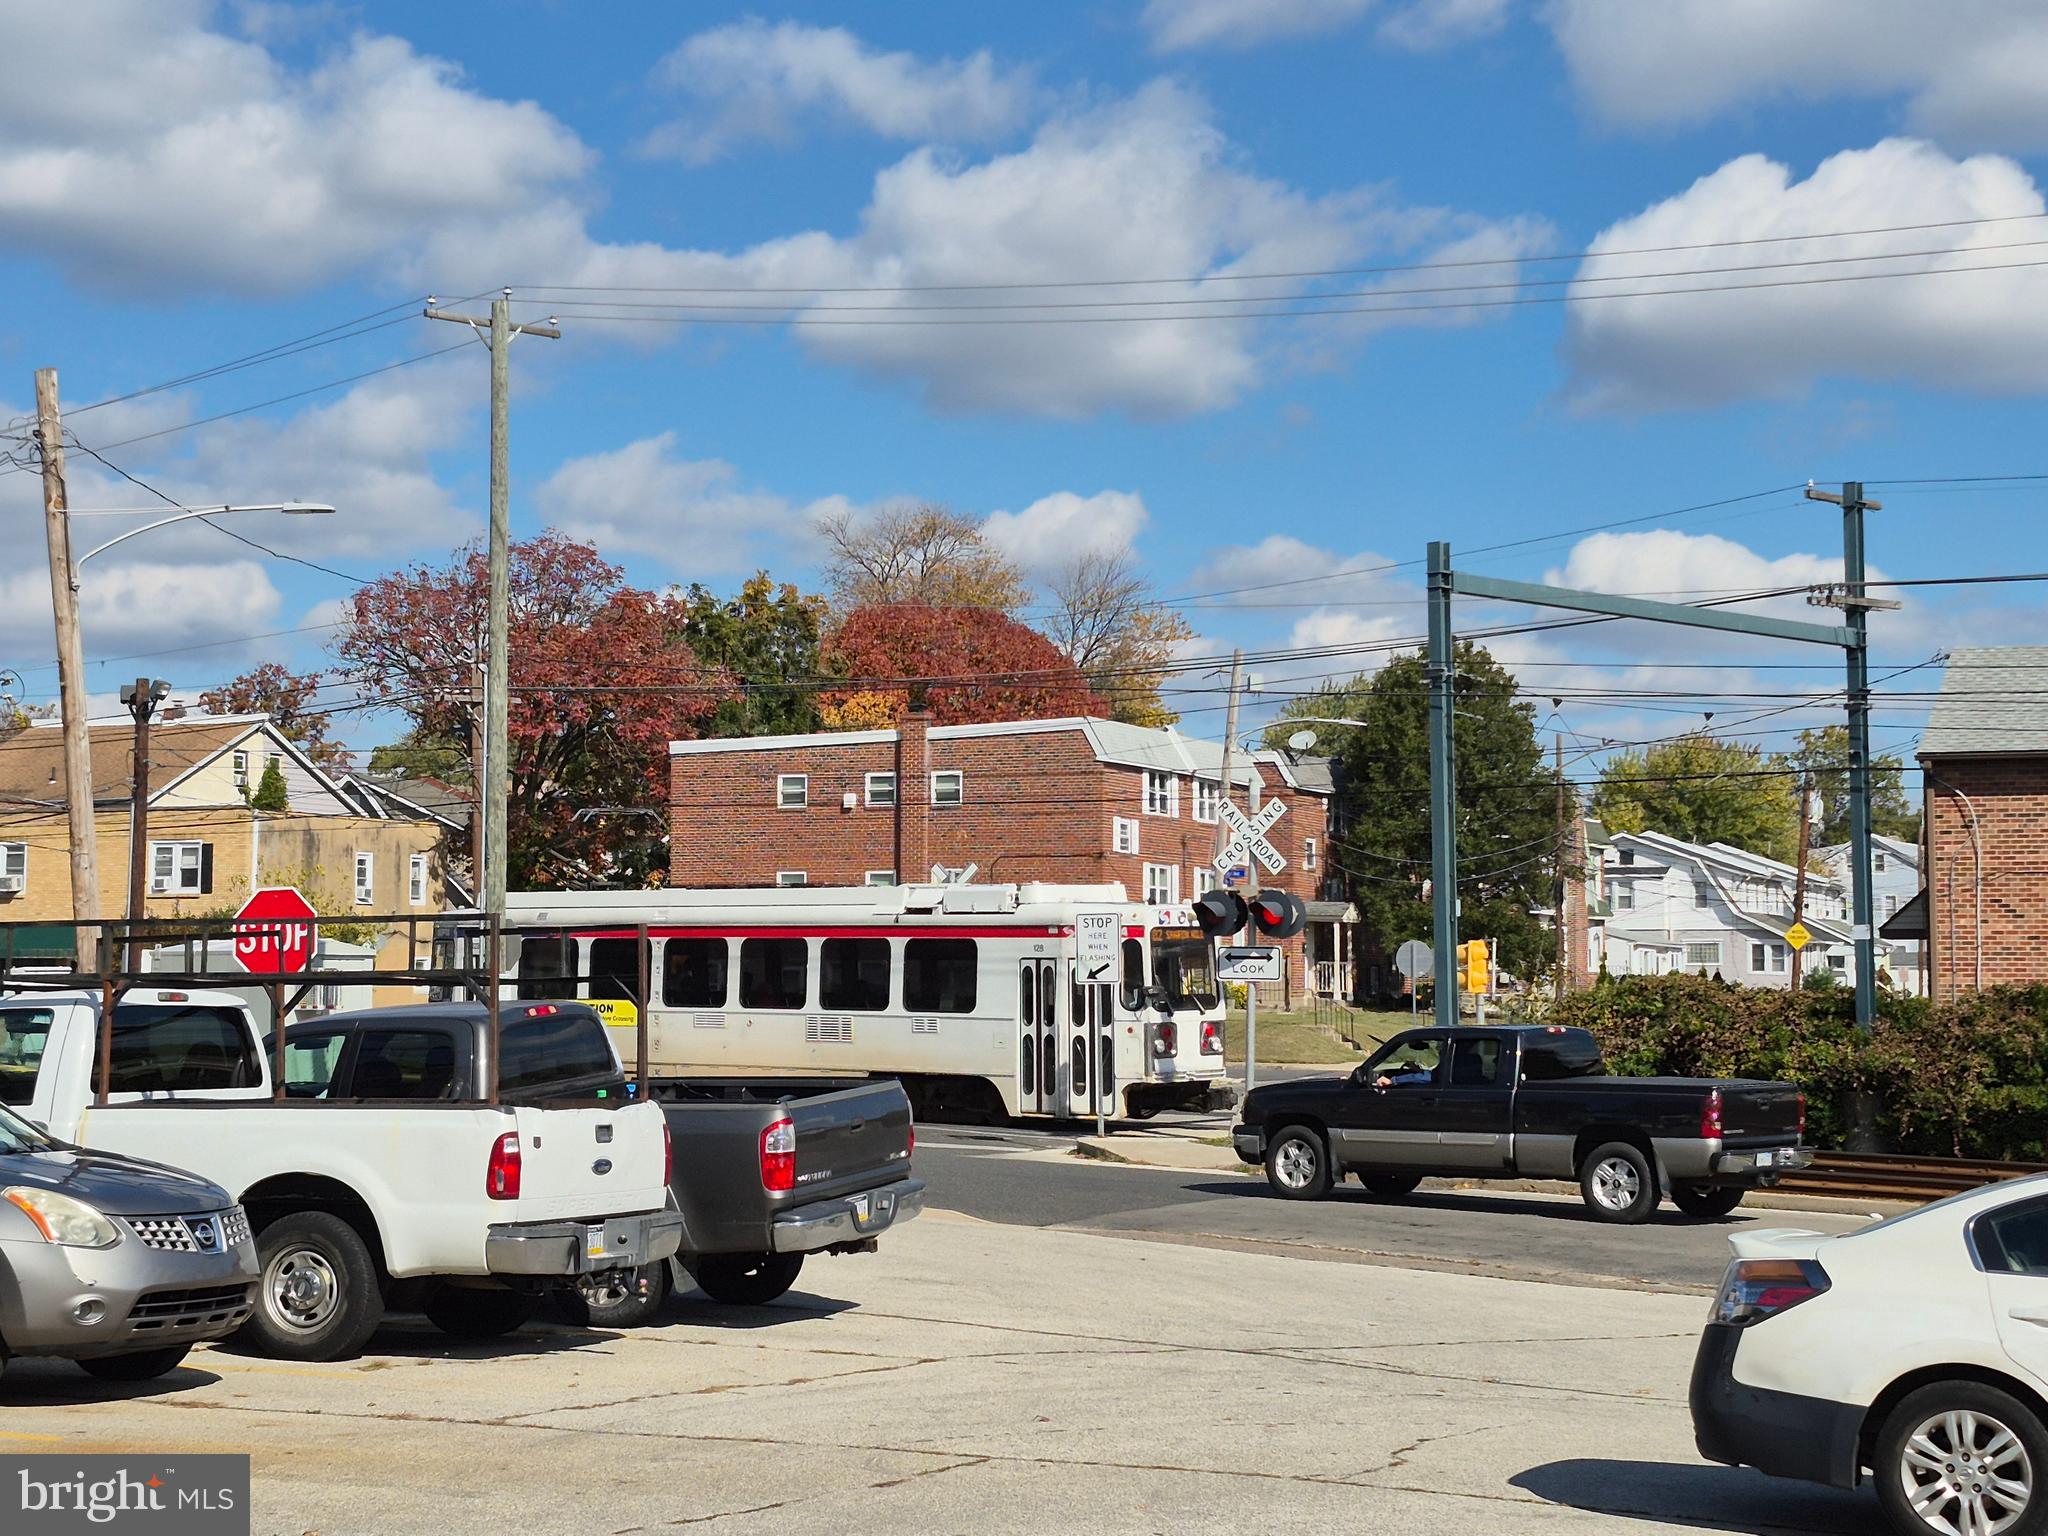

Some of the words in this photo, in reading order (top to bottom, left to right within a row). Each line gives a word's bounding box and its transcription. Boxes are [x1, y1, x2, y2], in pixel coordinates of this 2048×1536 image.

[1218, 802, 1282, 869] CROSSING
[1083, 917, 1112, 928] STOP
[239, 920, 308, 954] STOP
[1232, 965, 1265, 973] LOOK
